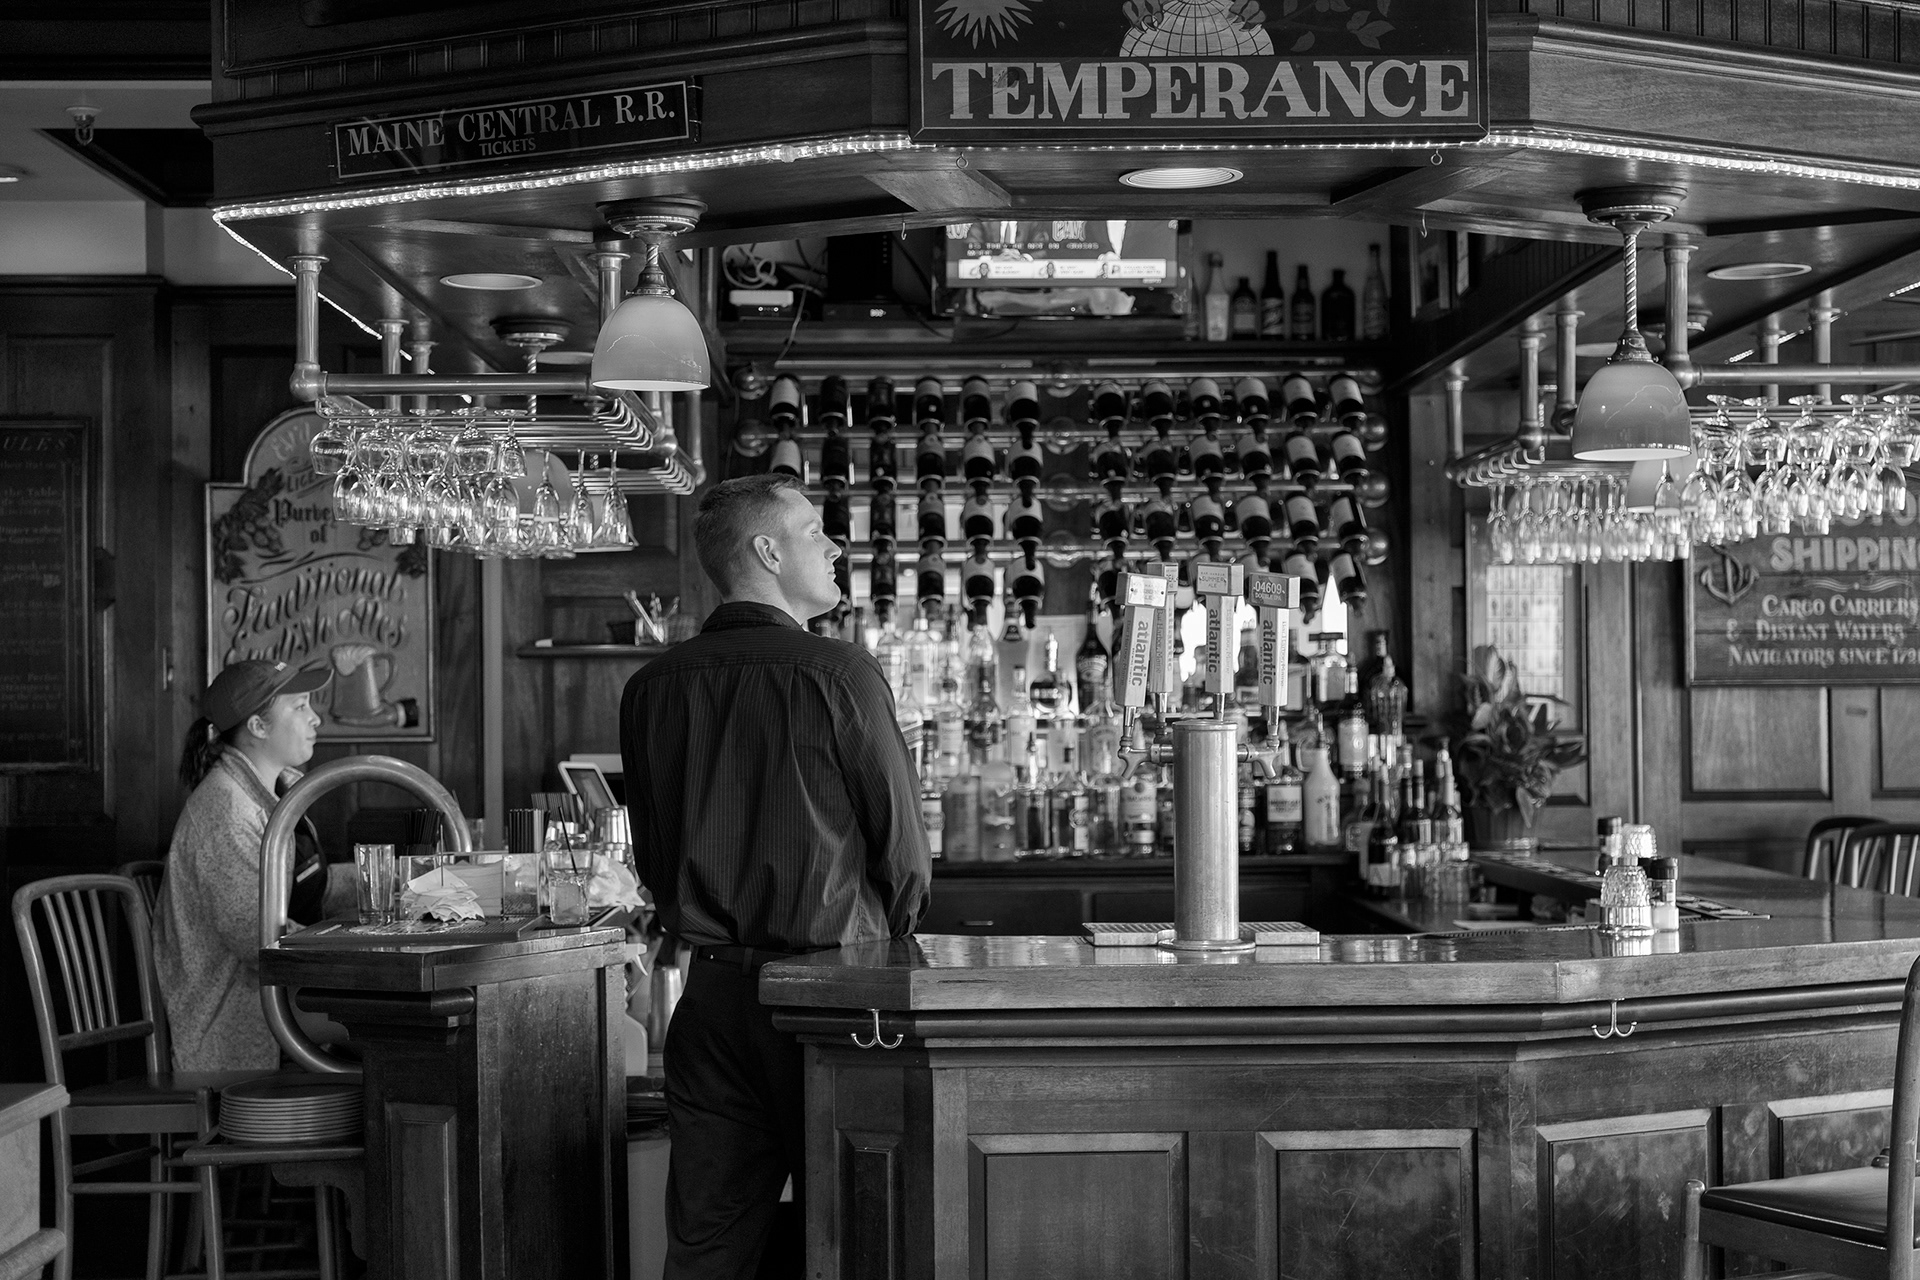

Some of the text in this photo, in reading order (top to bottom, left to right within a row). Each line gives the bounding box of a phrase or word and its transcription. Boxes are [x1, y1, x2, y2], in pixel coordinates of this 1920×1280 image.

[932, 59, 1469, 122] TEMPERANCE
[348, 91, 675, 157] MAINE CENTRAL R.R.
[479, 138, 537, 157] TICKETS
[310, 523, 327, 543] of
[1770, 537, 1920, 571] SHIPPIN
[1132, 620, 1149, 687] atlantic
[1208, 609, 1220, 673] atlantic
[1263, 620, 1276, 685] atlantic
